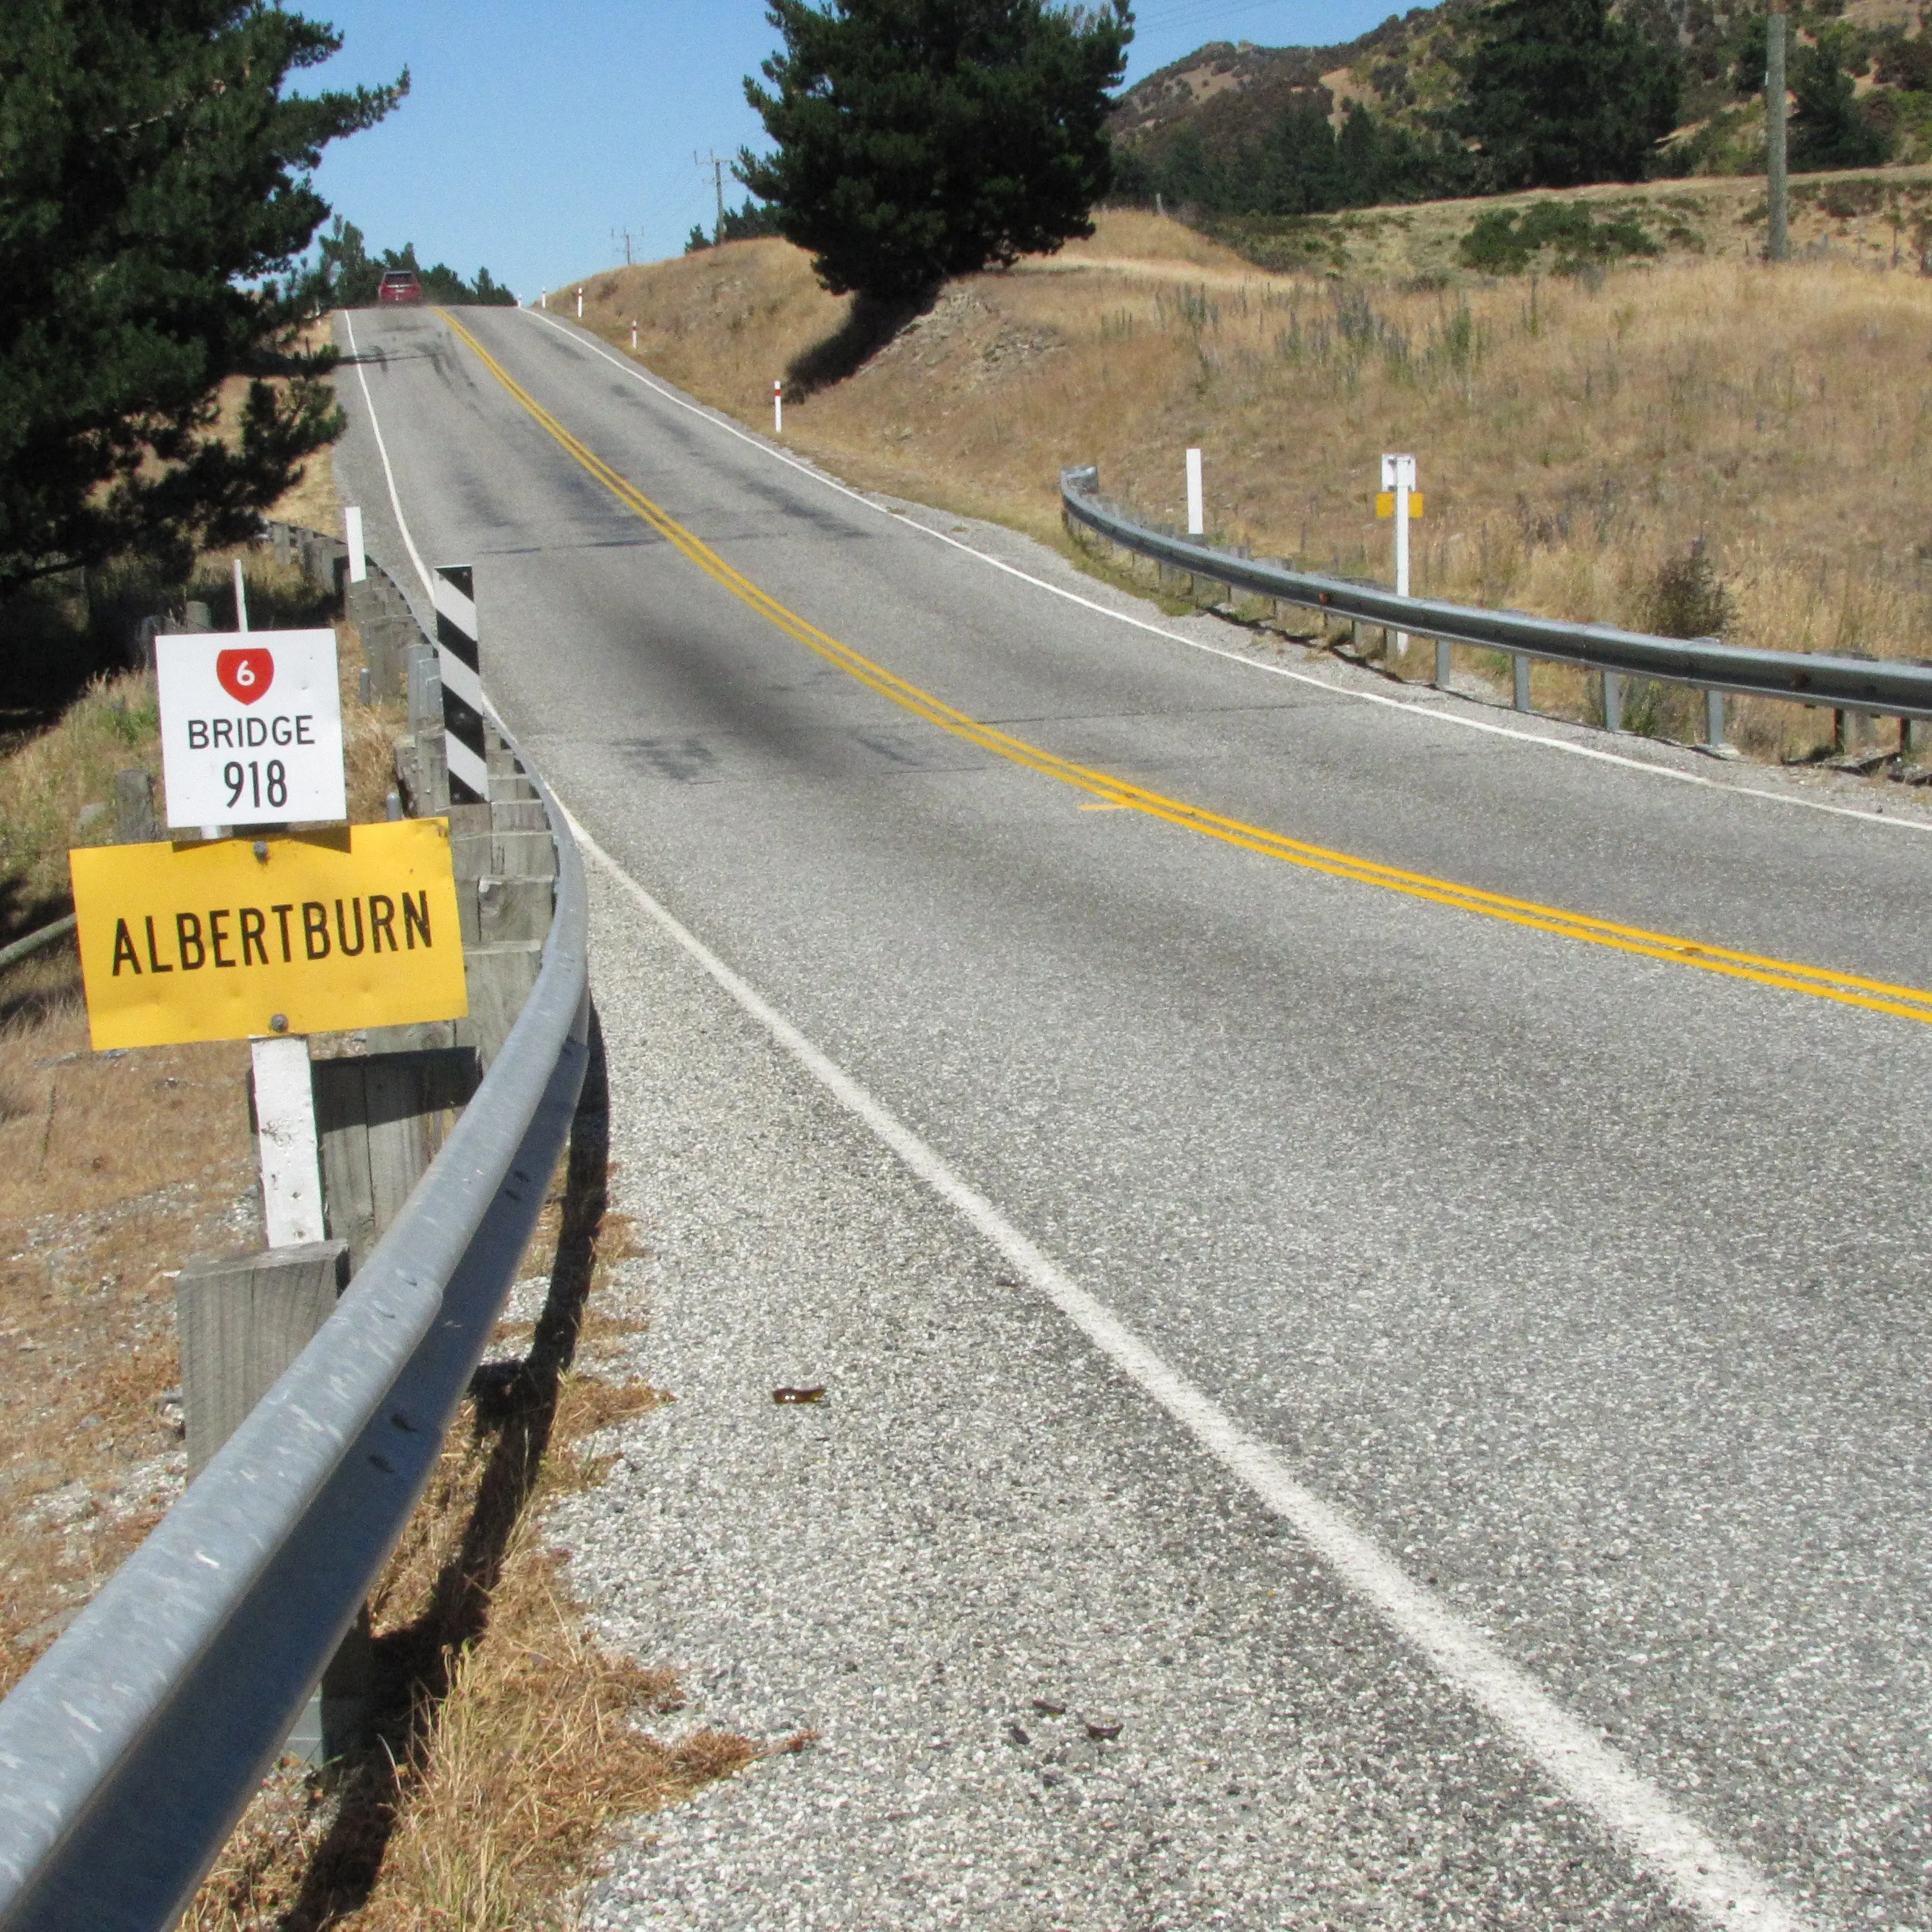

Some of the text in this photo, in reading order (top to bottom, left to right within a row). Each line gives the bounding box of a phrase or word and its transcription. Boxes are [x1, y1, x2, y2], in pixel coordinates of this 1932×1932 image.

[236, 660, 255, 687] 6
[187, 715, 316, 750] BRIDGE
[223, 759, 288, 809] 918
[111, 890, 433, 977] ALBERTBURN
